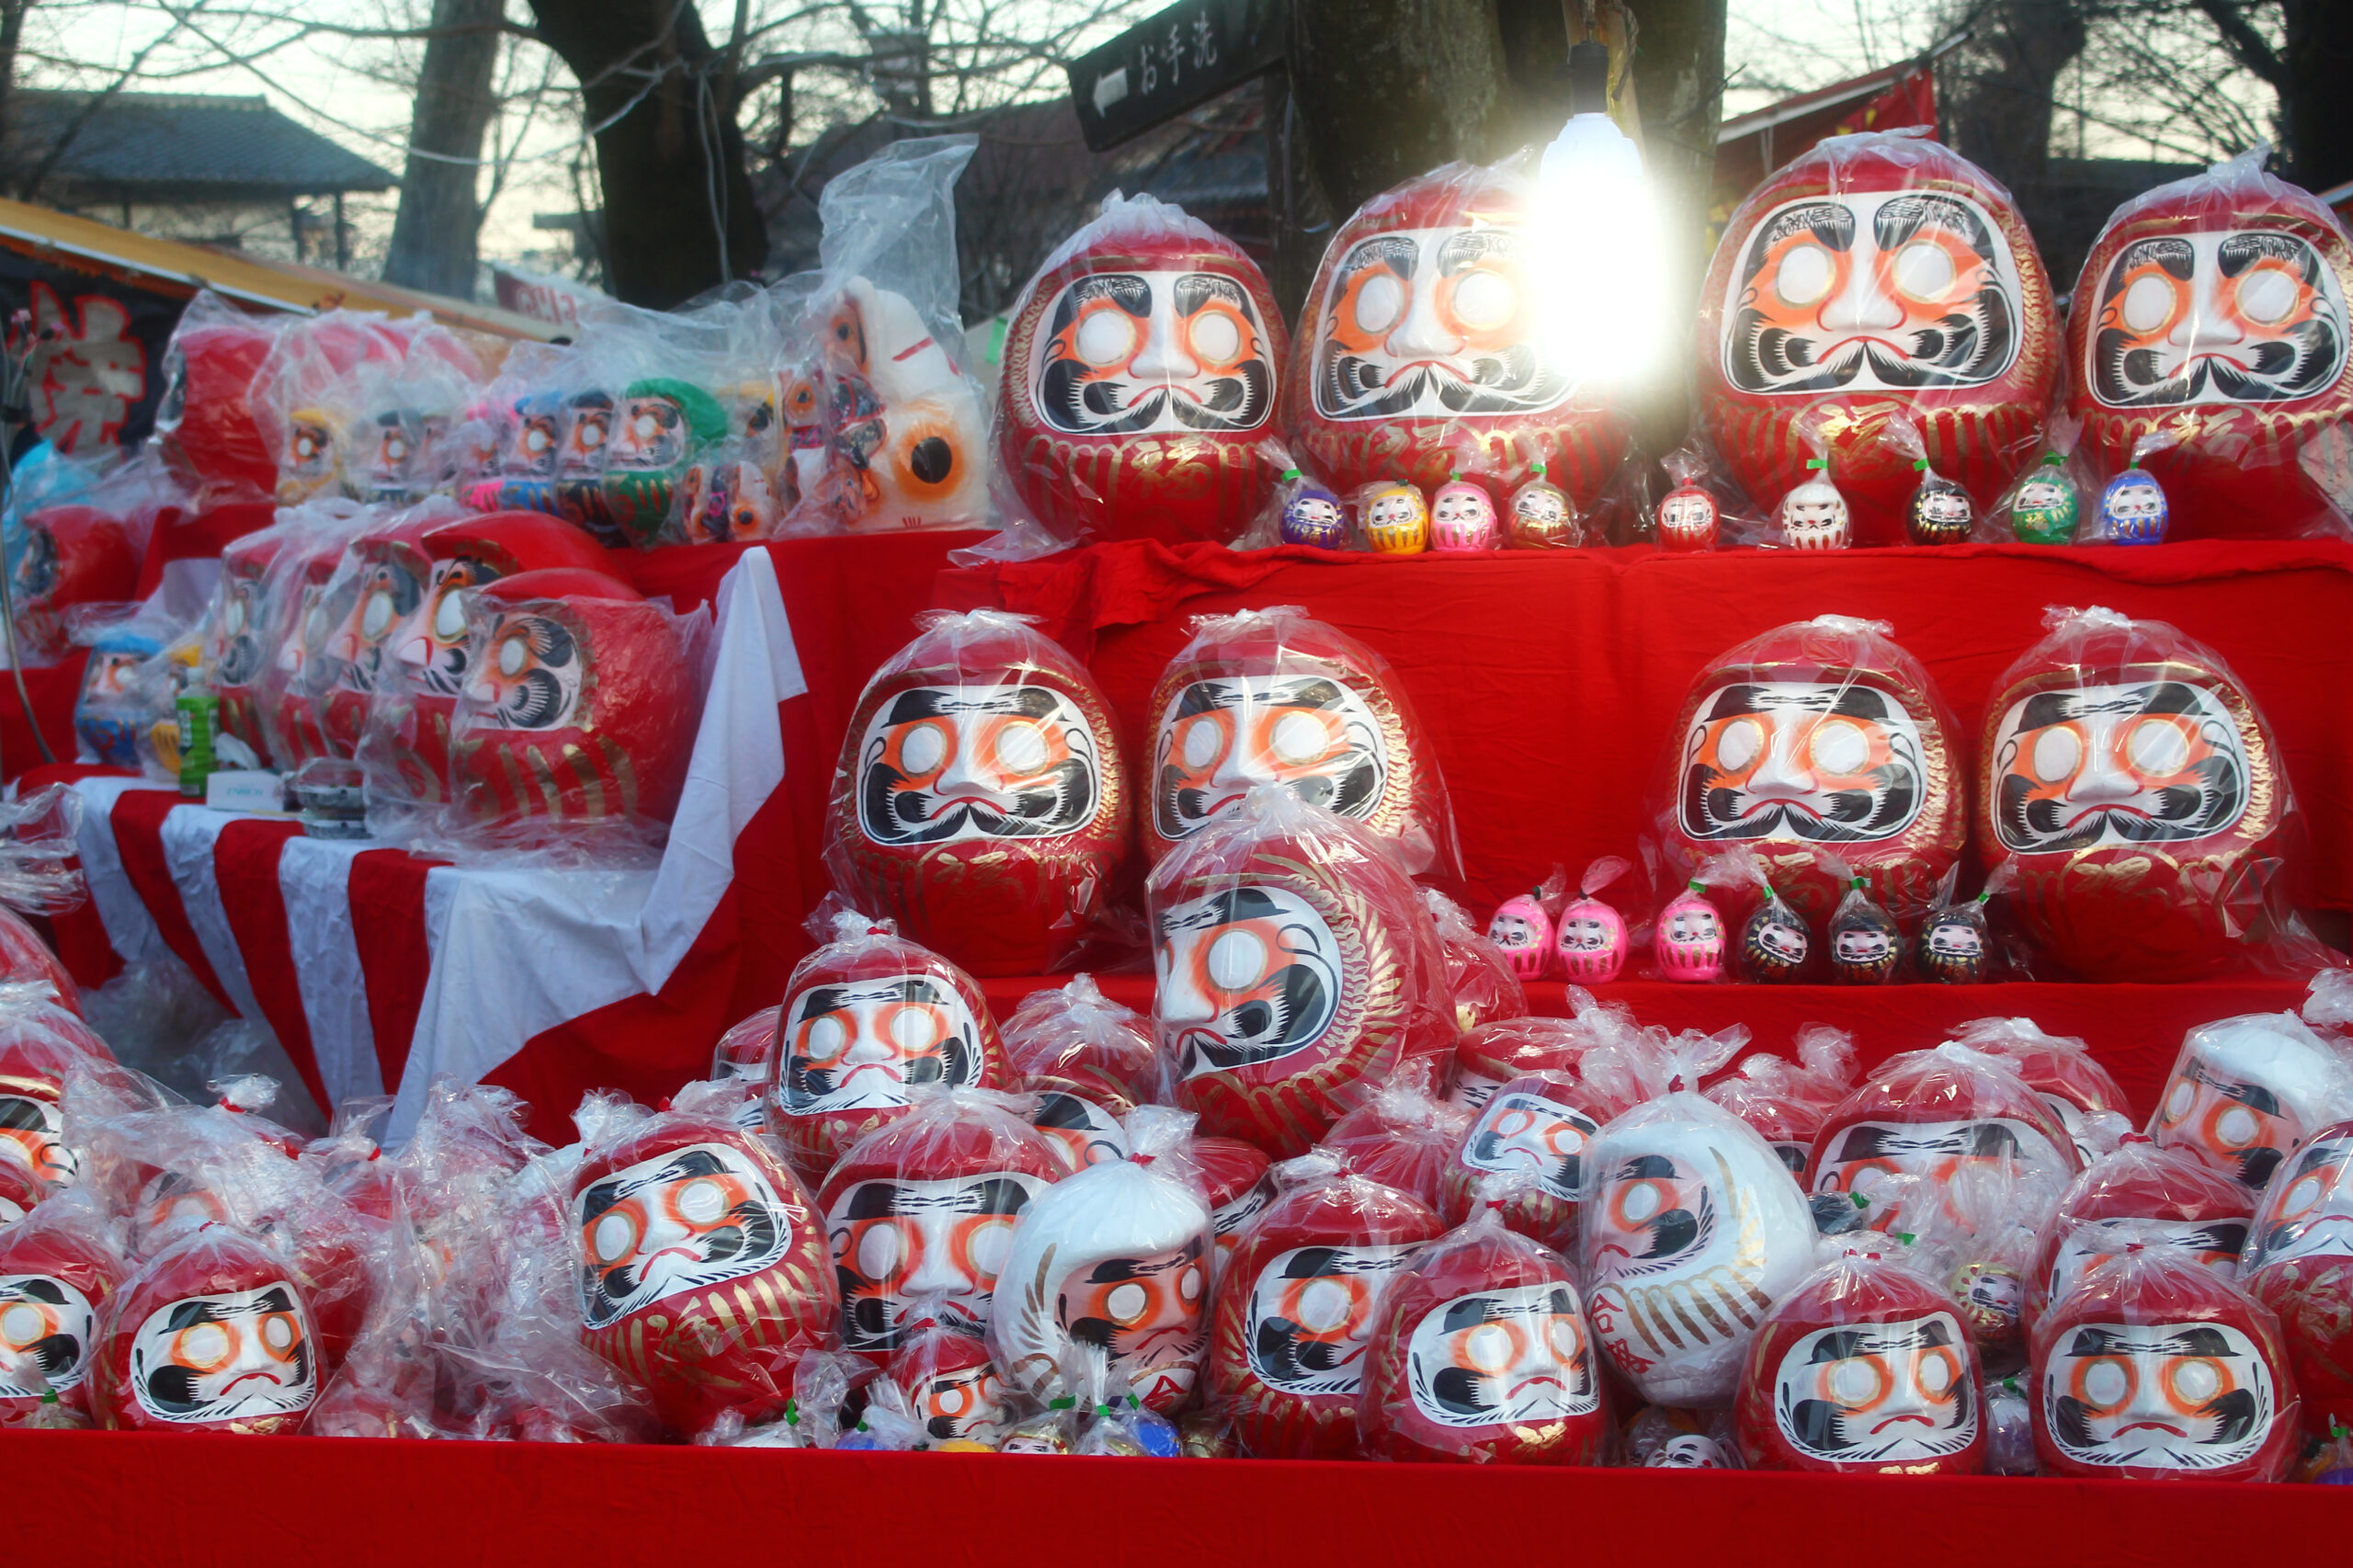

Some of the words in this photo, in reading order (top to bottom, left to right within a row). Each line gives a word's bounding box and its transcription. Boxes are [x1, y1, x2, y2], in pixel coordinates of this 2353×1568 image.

[1141, 9, 1218, 95] お手洗
[1587, 1292, 1656, 1377] 合格
